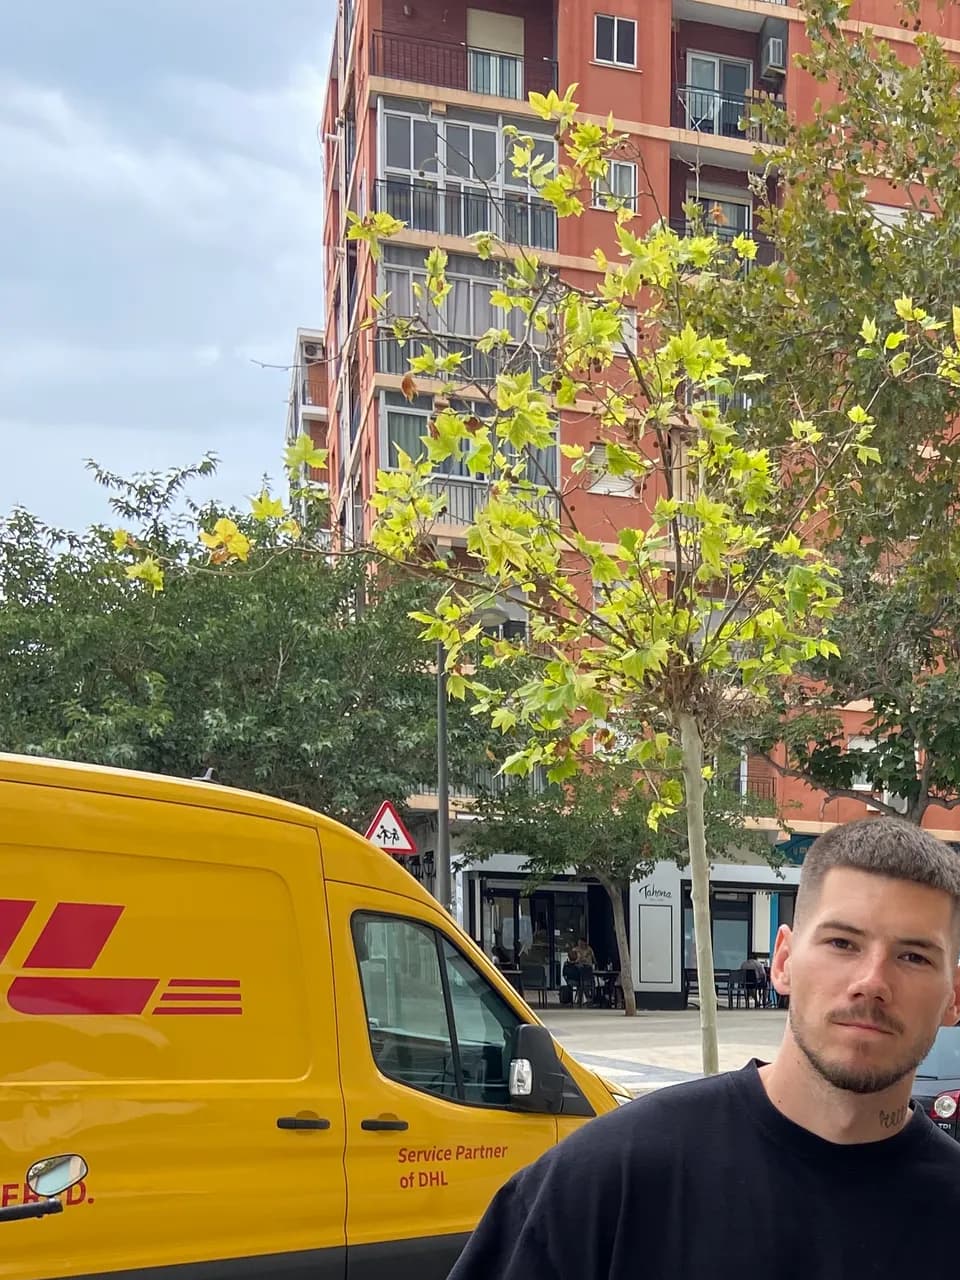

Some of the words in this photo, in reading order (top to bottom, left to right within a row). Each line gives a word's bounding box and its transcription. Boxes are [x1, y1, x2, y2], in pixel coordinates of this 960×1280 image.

[398, 1146, 452, 1163] Service
[455, 1144, 508, 1160] Partner
[400, 1172, 415, 1189] of
[418, 1171, 448, 1187] DHL
